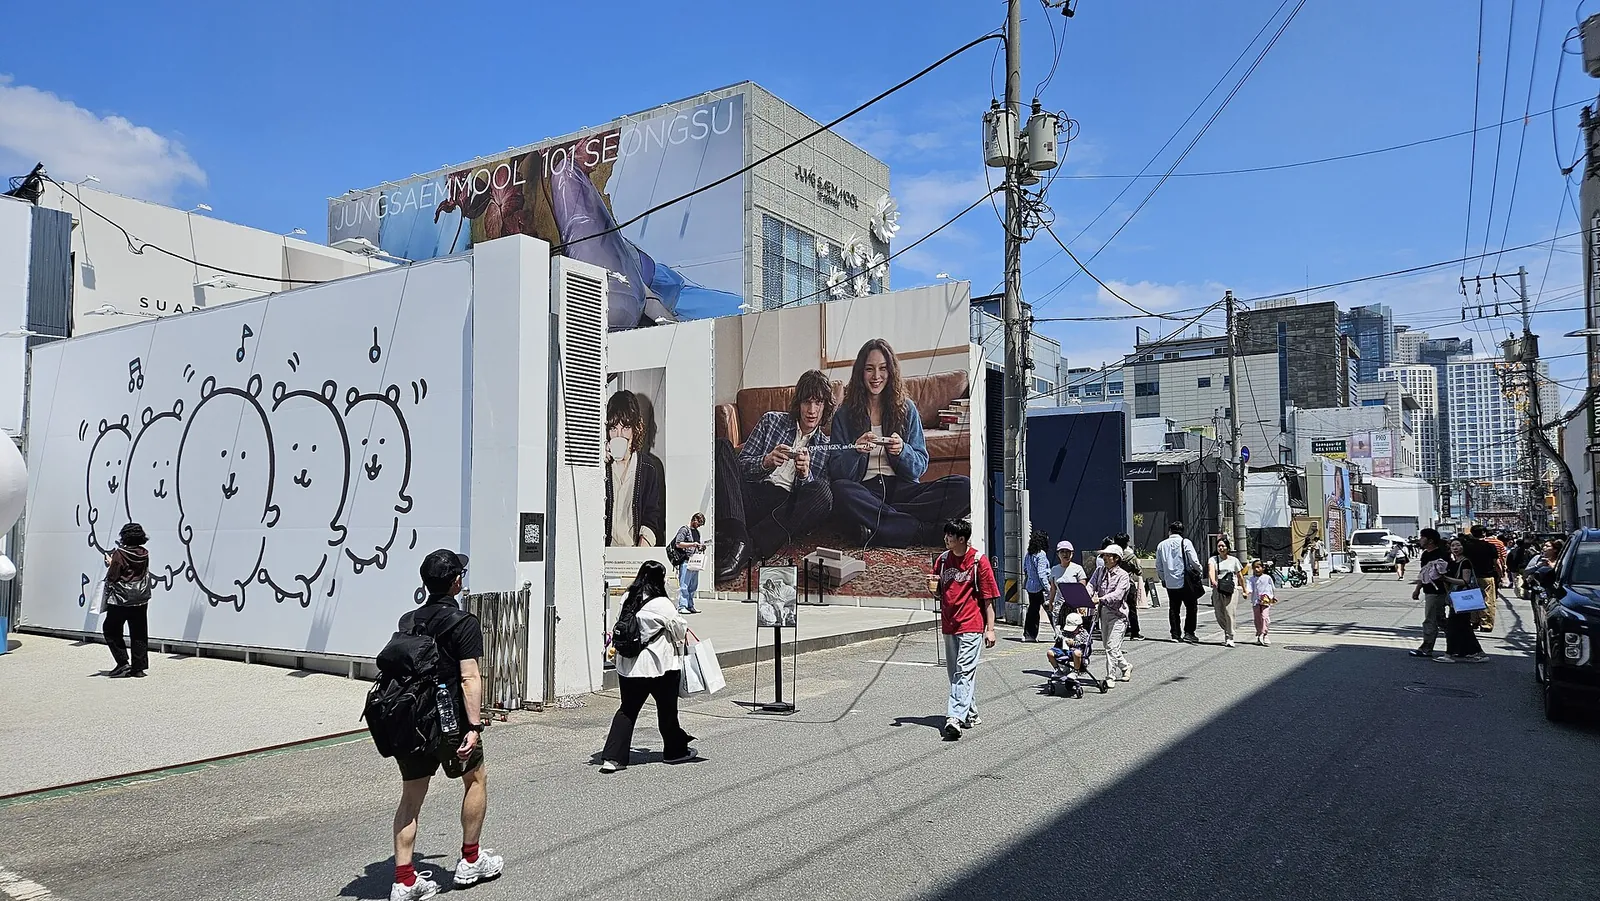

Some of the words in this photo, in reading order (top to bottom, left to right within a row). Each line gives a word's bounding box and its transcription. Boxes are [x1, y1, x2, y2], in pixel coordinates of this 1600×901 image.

[335, 160, 526, 231] JUNGSAEMMOOL
[541, 144, 577, 179] 101
[584, 102, 733, 168] SEONGSU
